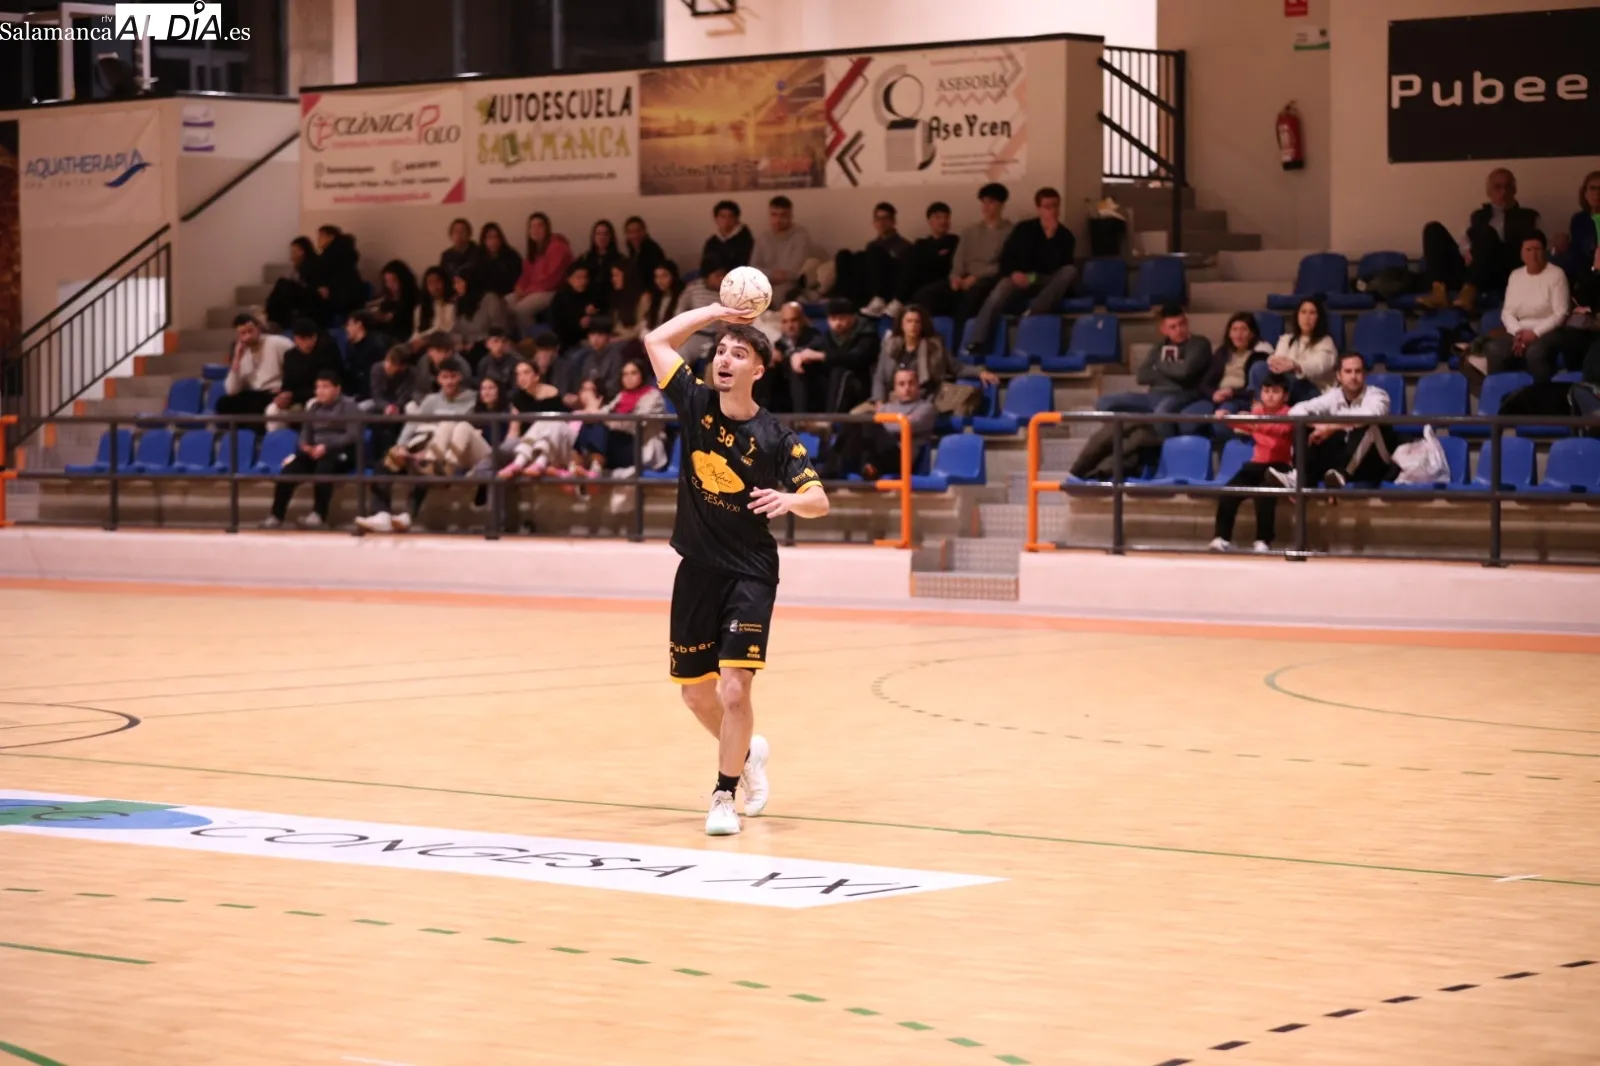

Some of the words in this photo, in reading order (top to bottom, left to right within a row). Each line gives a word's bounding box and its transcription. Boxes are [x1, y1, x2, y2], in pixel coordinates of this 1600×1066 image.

[483, 86, 633, 125] AUTOESCUELA
[25, 148, 148, 179] AQUATHERAPIA
[476, 124, 633, 167] SALAMANCA
[716, 425, 735, 448] 38
[189, 826, 698, 879] CONGESA
[701, 871, 922, 898] XXI
